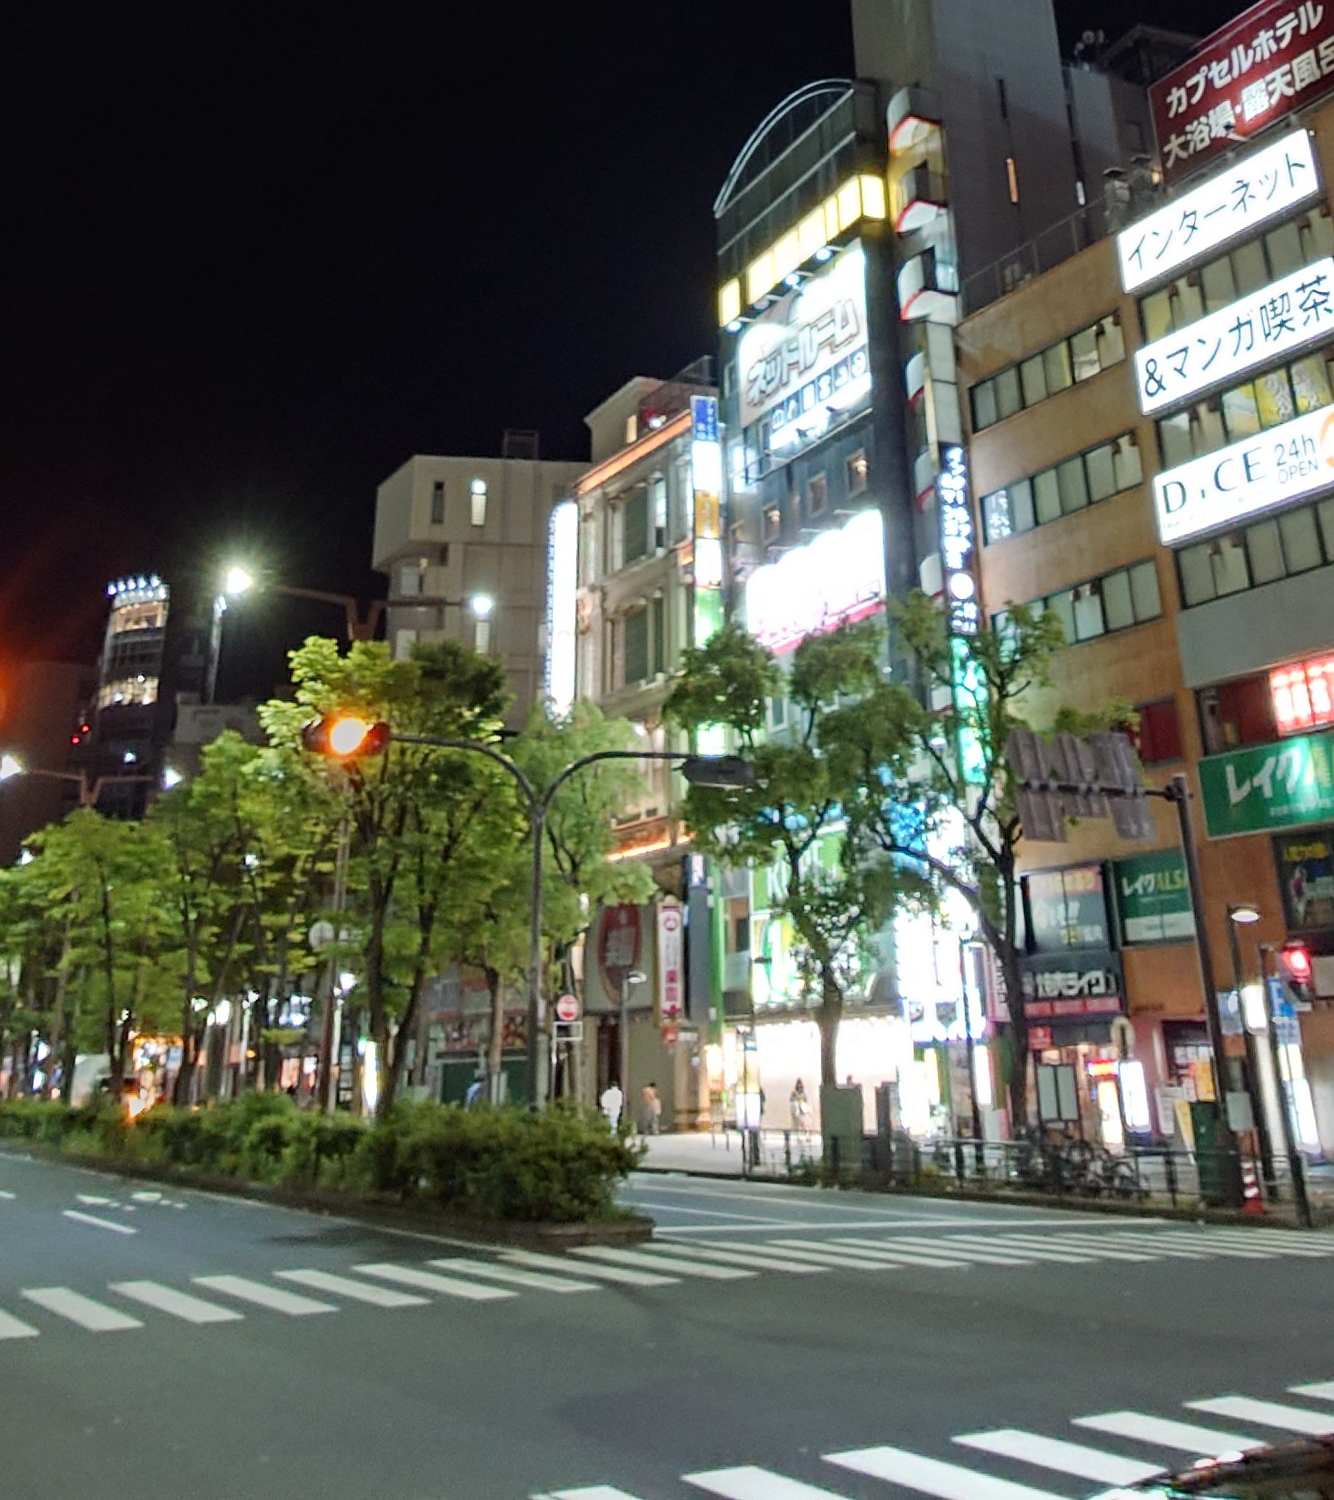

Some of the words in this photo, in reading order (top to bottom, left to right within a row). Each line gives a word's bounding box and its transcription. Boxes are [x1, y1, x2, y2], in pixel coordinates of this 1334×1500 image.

[1166, 0, 1324, 119] カプセルホテル
[1128, 153, 1307, 272] インターネット
[1144, 275, 1334, 398] &マンガ喫茶
[1273, 434, 1317, 468] 24h
[1277, 458, 1319, 485] OPEN
[1123, 872, 1186, 898] レイクALS
